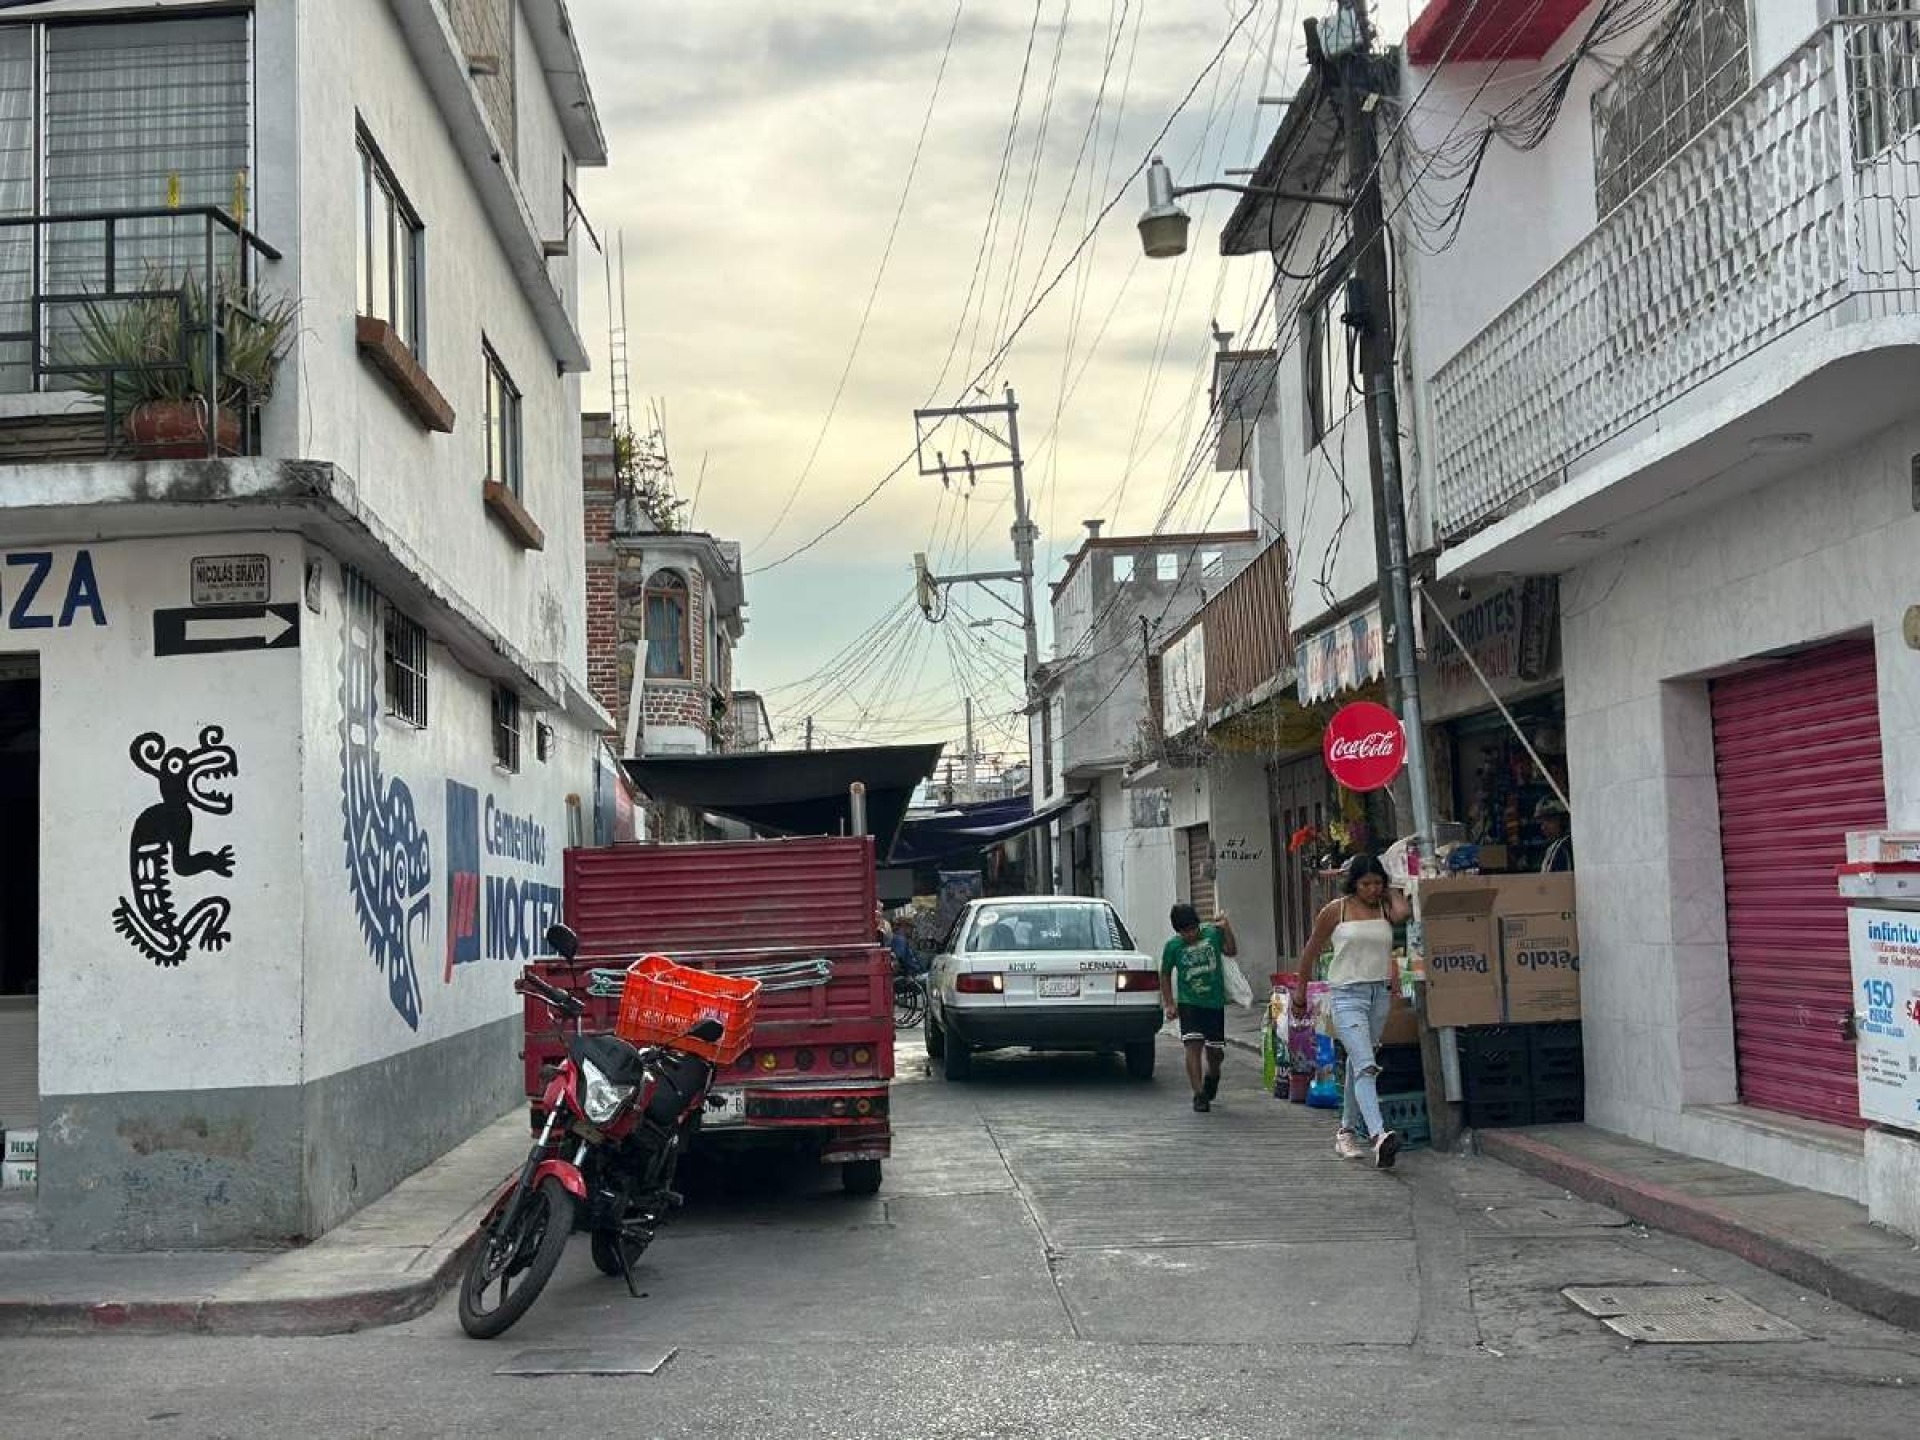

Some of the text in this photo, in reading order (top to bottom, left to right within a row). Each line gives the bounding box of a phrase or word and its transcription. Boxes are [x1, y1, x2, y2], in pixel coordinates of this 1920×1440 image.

[0, 550, 107, 629] ZA
[485, 793, 545, 866] Cementos
[1869, 920, 1920, 943] infinitu
[1432, 954, 1489, 973] Pétalo
[1863, 979, 1894, 1008] 150
